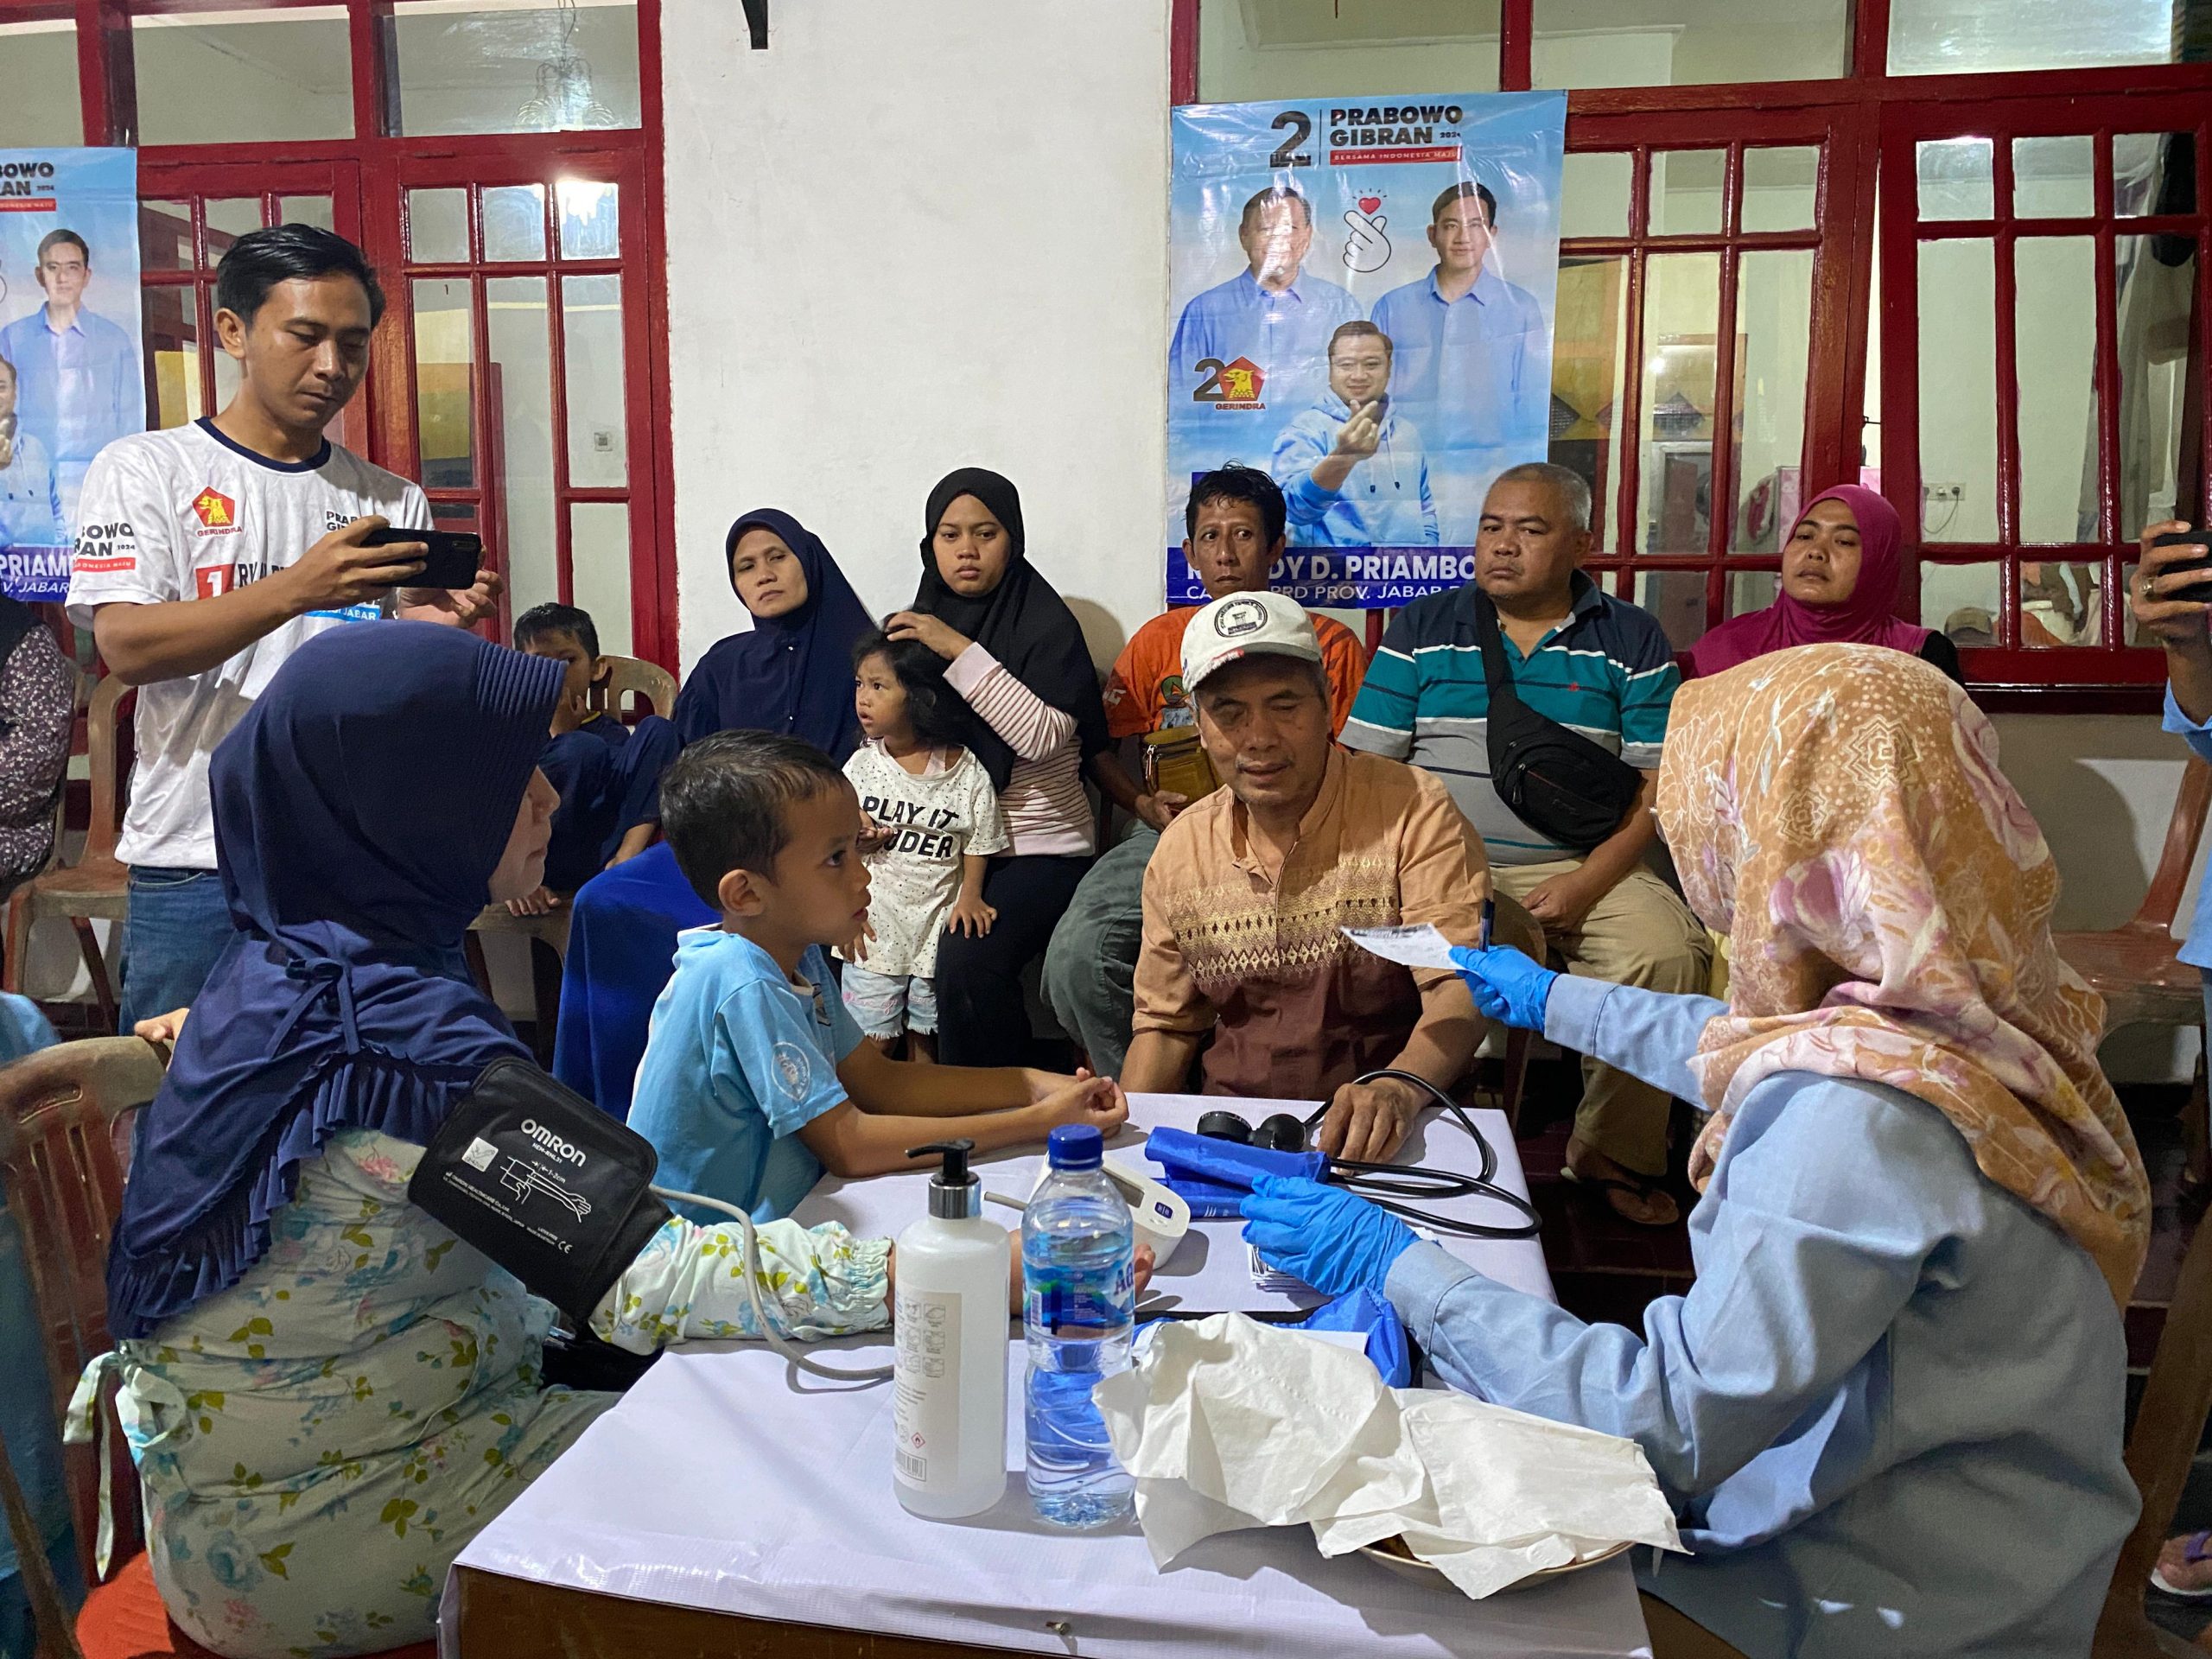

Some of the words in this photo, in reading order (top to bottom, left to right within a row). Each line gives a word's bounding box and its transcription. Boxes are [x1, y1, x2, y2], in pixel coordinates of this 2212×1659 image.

[1330, 105, 1463, 126] PRABOWO
[1270, 111, 1312, 168] 2
[1329, 127, 1433, 146] GIBRAN
[0, 162, 54, 178] OWO
[81, 522, 134, 540] OWO
[197, 526, 243, 537] GERINDRA
[1311, 556, 1338, 580] D.
[18, 582, 69, 594] JABAR
[207, 570, 222, 598] 1
[1314, 585, 1371, 600] PROV.
[863, 796, 926, 824] PLAY
[928, 809, 960, 829] IT
[520, 1118, 587, 1167] OMRON
[547, 1170, 566, 1184] 1-2cm
